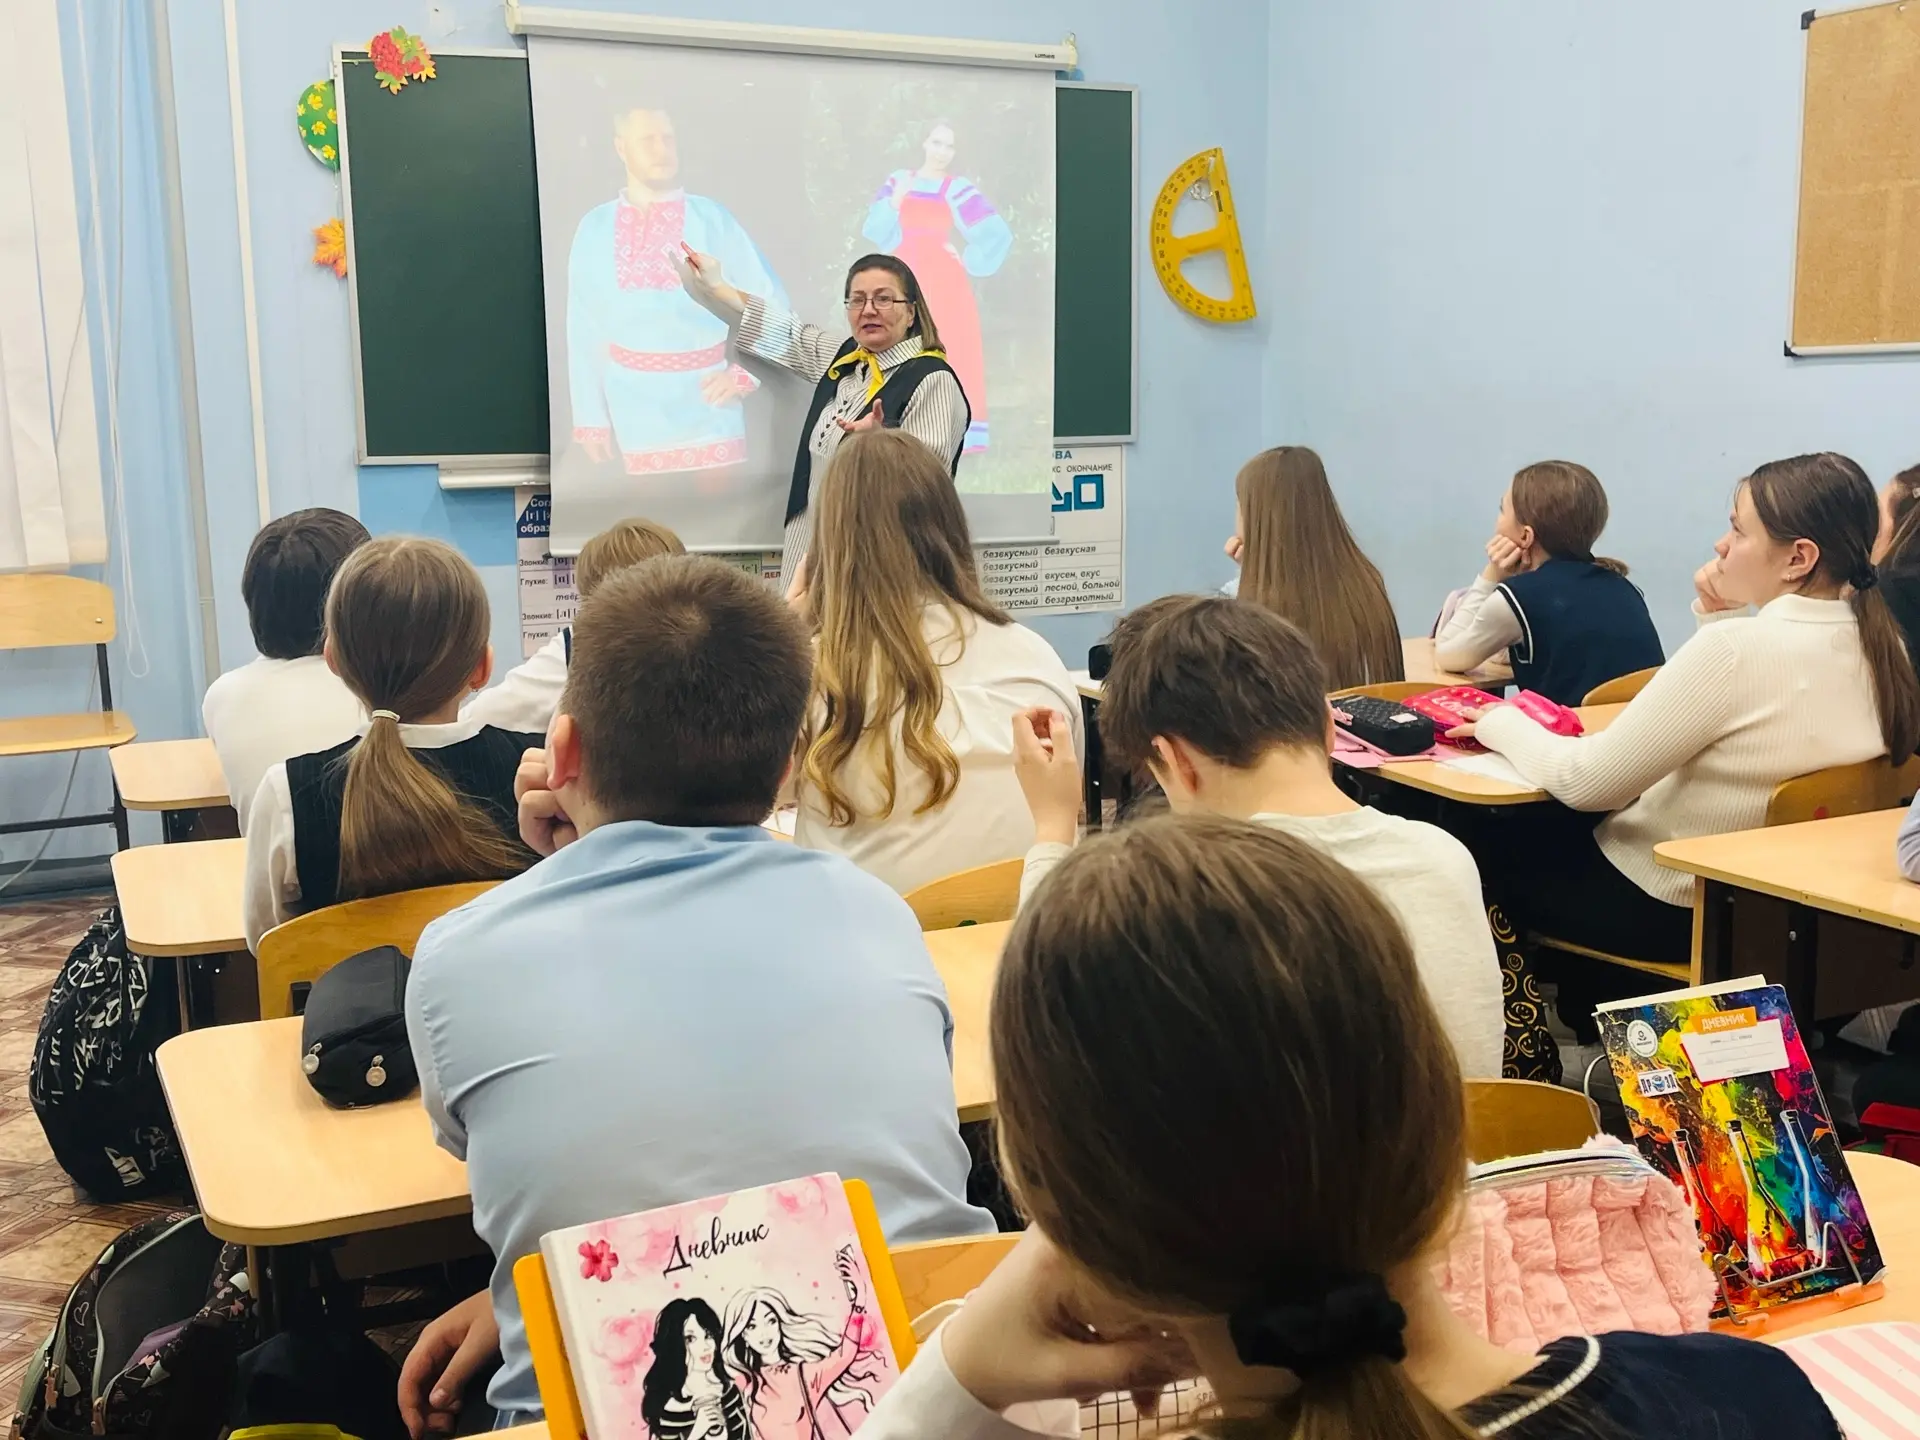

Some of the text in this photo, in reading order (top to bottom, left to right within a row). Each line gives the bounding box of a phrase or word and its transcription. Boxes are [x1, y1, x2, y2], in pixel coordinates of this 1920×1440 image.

[1053, 450, 1072, 459] ВА
[1066, 463, 1113, 473] ОКОНЧАНИЕ
[983, 546, 1096, 560] безвкусный безвкусная
[983, 559, 1039, 572] безвкусный
[983, 572, 1039, 585] безвкусный
[1044, 570, 1101, 581] вкусен, вкус
[1044, 582, 1080, 593] лесной,
[1081, 579, 1121, 590] больной
[1044, 592, 1115, 606] безграмотный
[1701, 1013, 1748, 1031] ДНЕВНИК
[662, 1216, 770, 1280] Дневник
